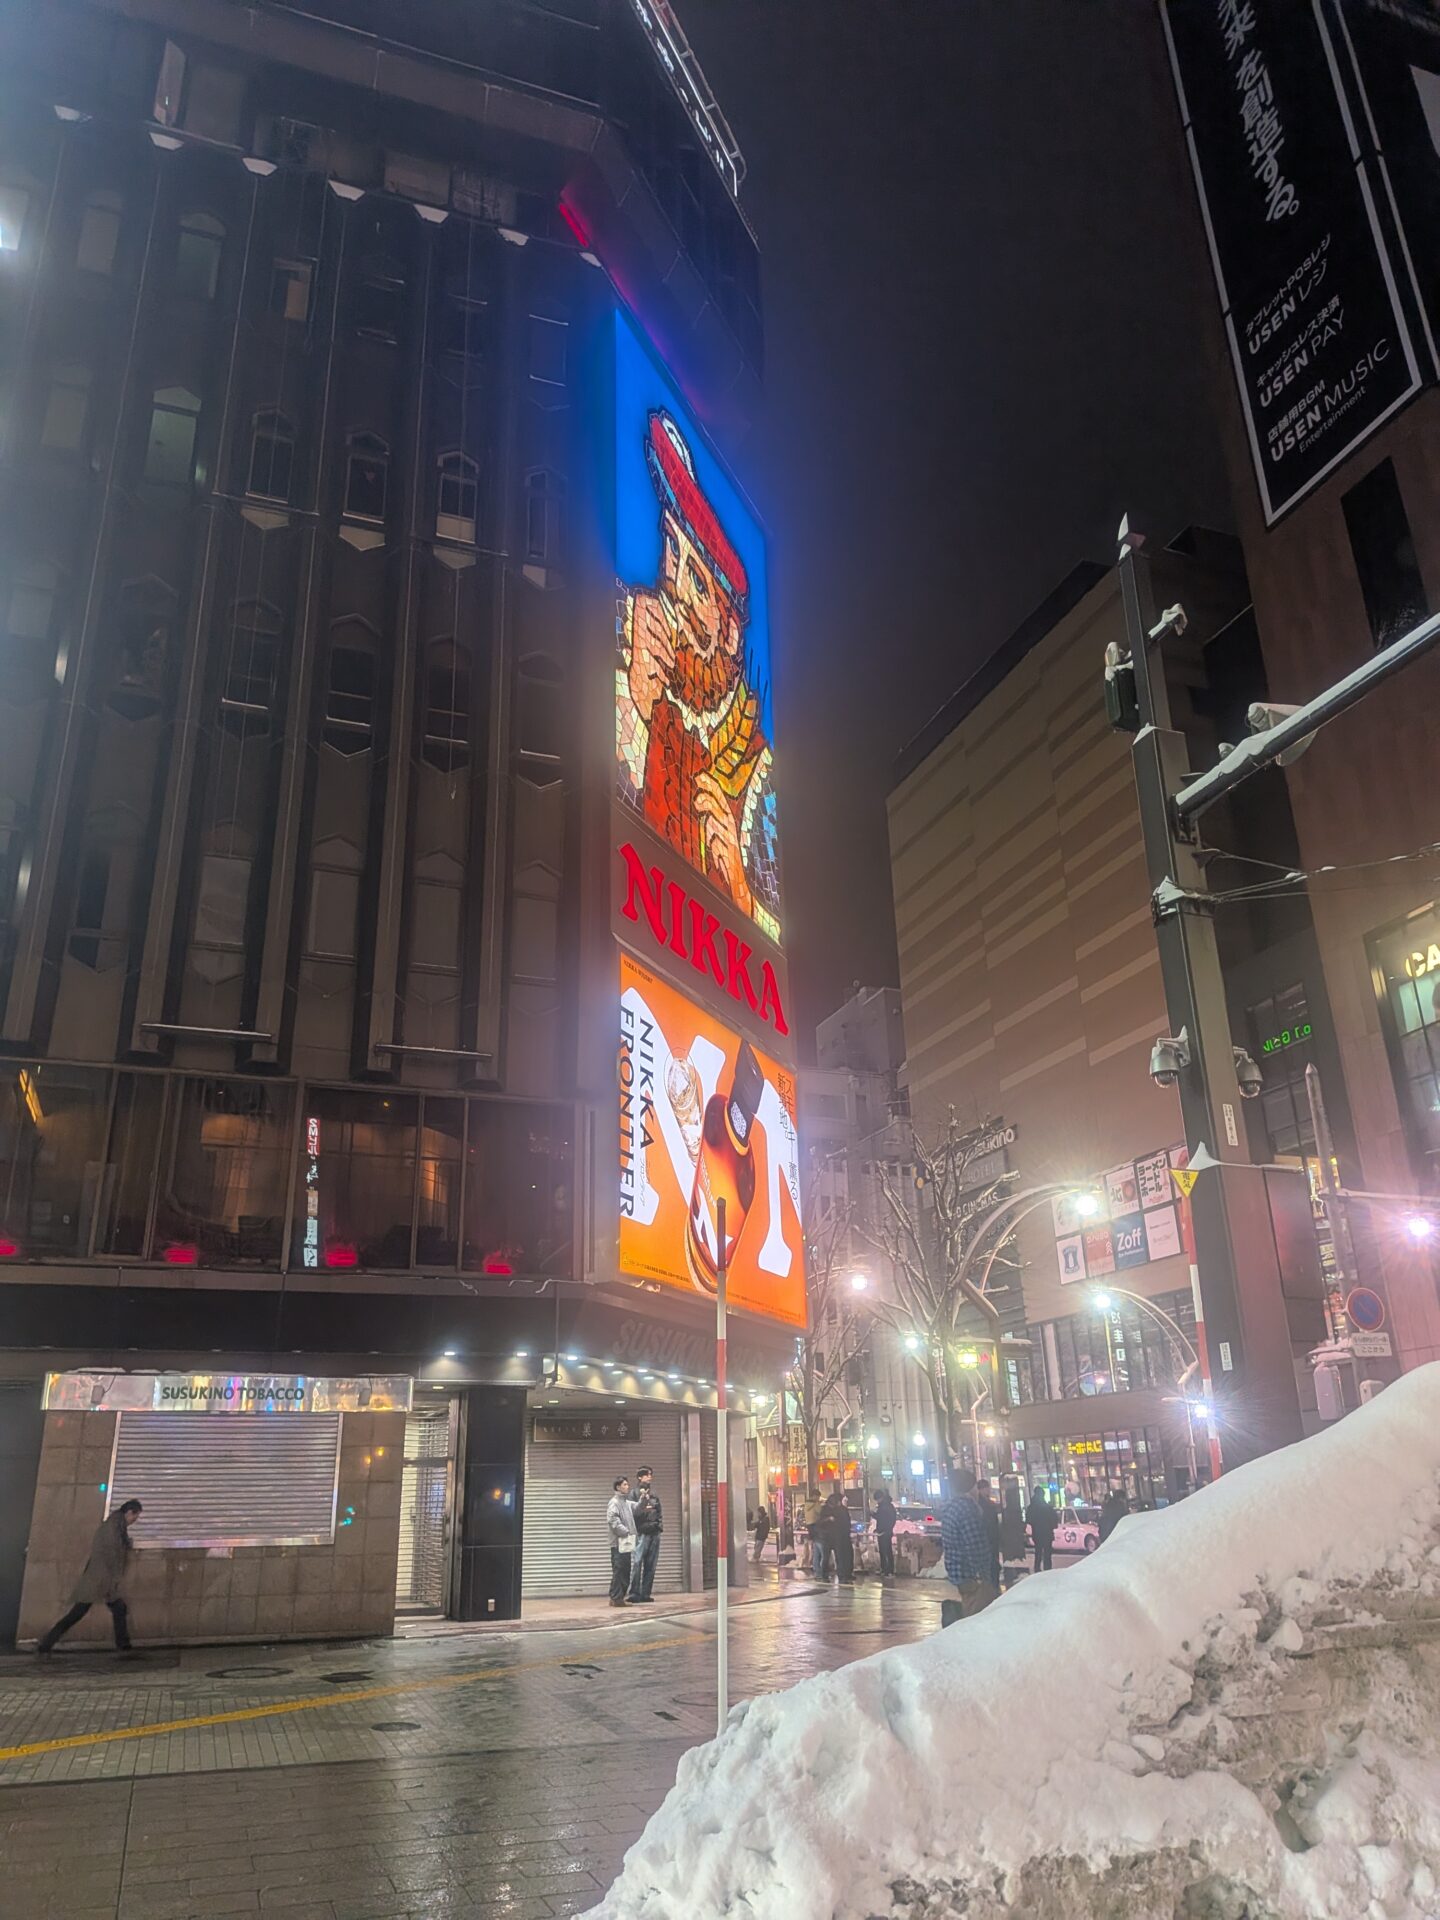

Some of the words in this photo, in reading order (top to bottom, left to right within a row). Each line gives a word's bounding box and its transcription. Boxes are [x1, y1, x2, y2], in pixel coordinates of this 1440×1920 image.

[1246, 233, 1331, 336] タブレットPOSレジ
[1249, 296, 1296, 355] USEN
[1298, 258, 1327, 302] レジ
[1256, 294, 1341, 388] キャッシュレス決済
[1260, 350, 1309, 408] USEN
[1311, 308, 1345, 356] PAY
[1268, 379, 1326, 444] 店舗用BGM
[1270, 404, 1322, 463] USEN
[1324, 337, 1390, 413] MUSIC
[1298, 385, 1367, 454] Entertainment
[619, 842, 790, 1037] NIKKA
[620, 1005, 635, 1217] FRONTIER
[639, 1016, 655, 1149] NIKKA
[1116, 1227, 1142, 1251] Zoff
[161, 1385, 235, 1402] SUSUKINO
[237, 1385, 306, 1402] TOBACCO
